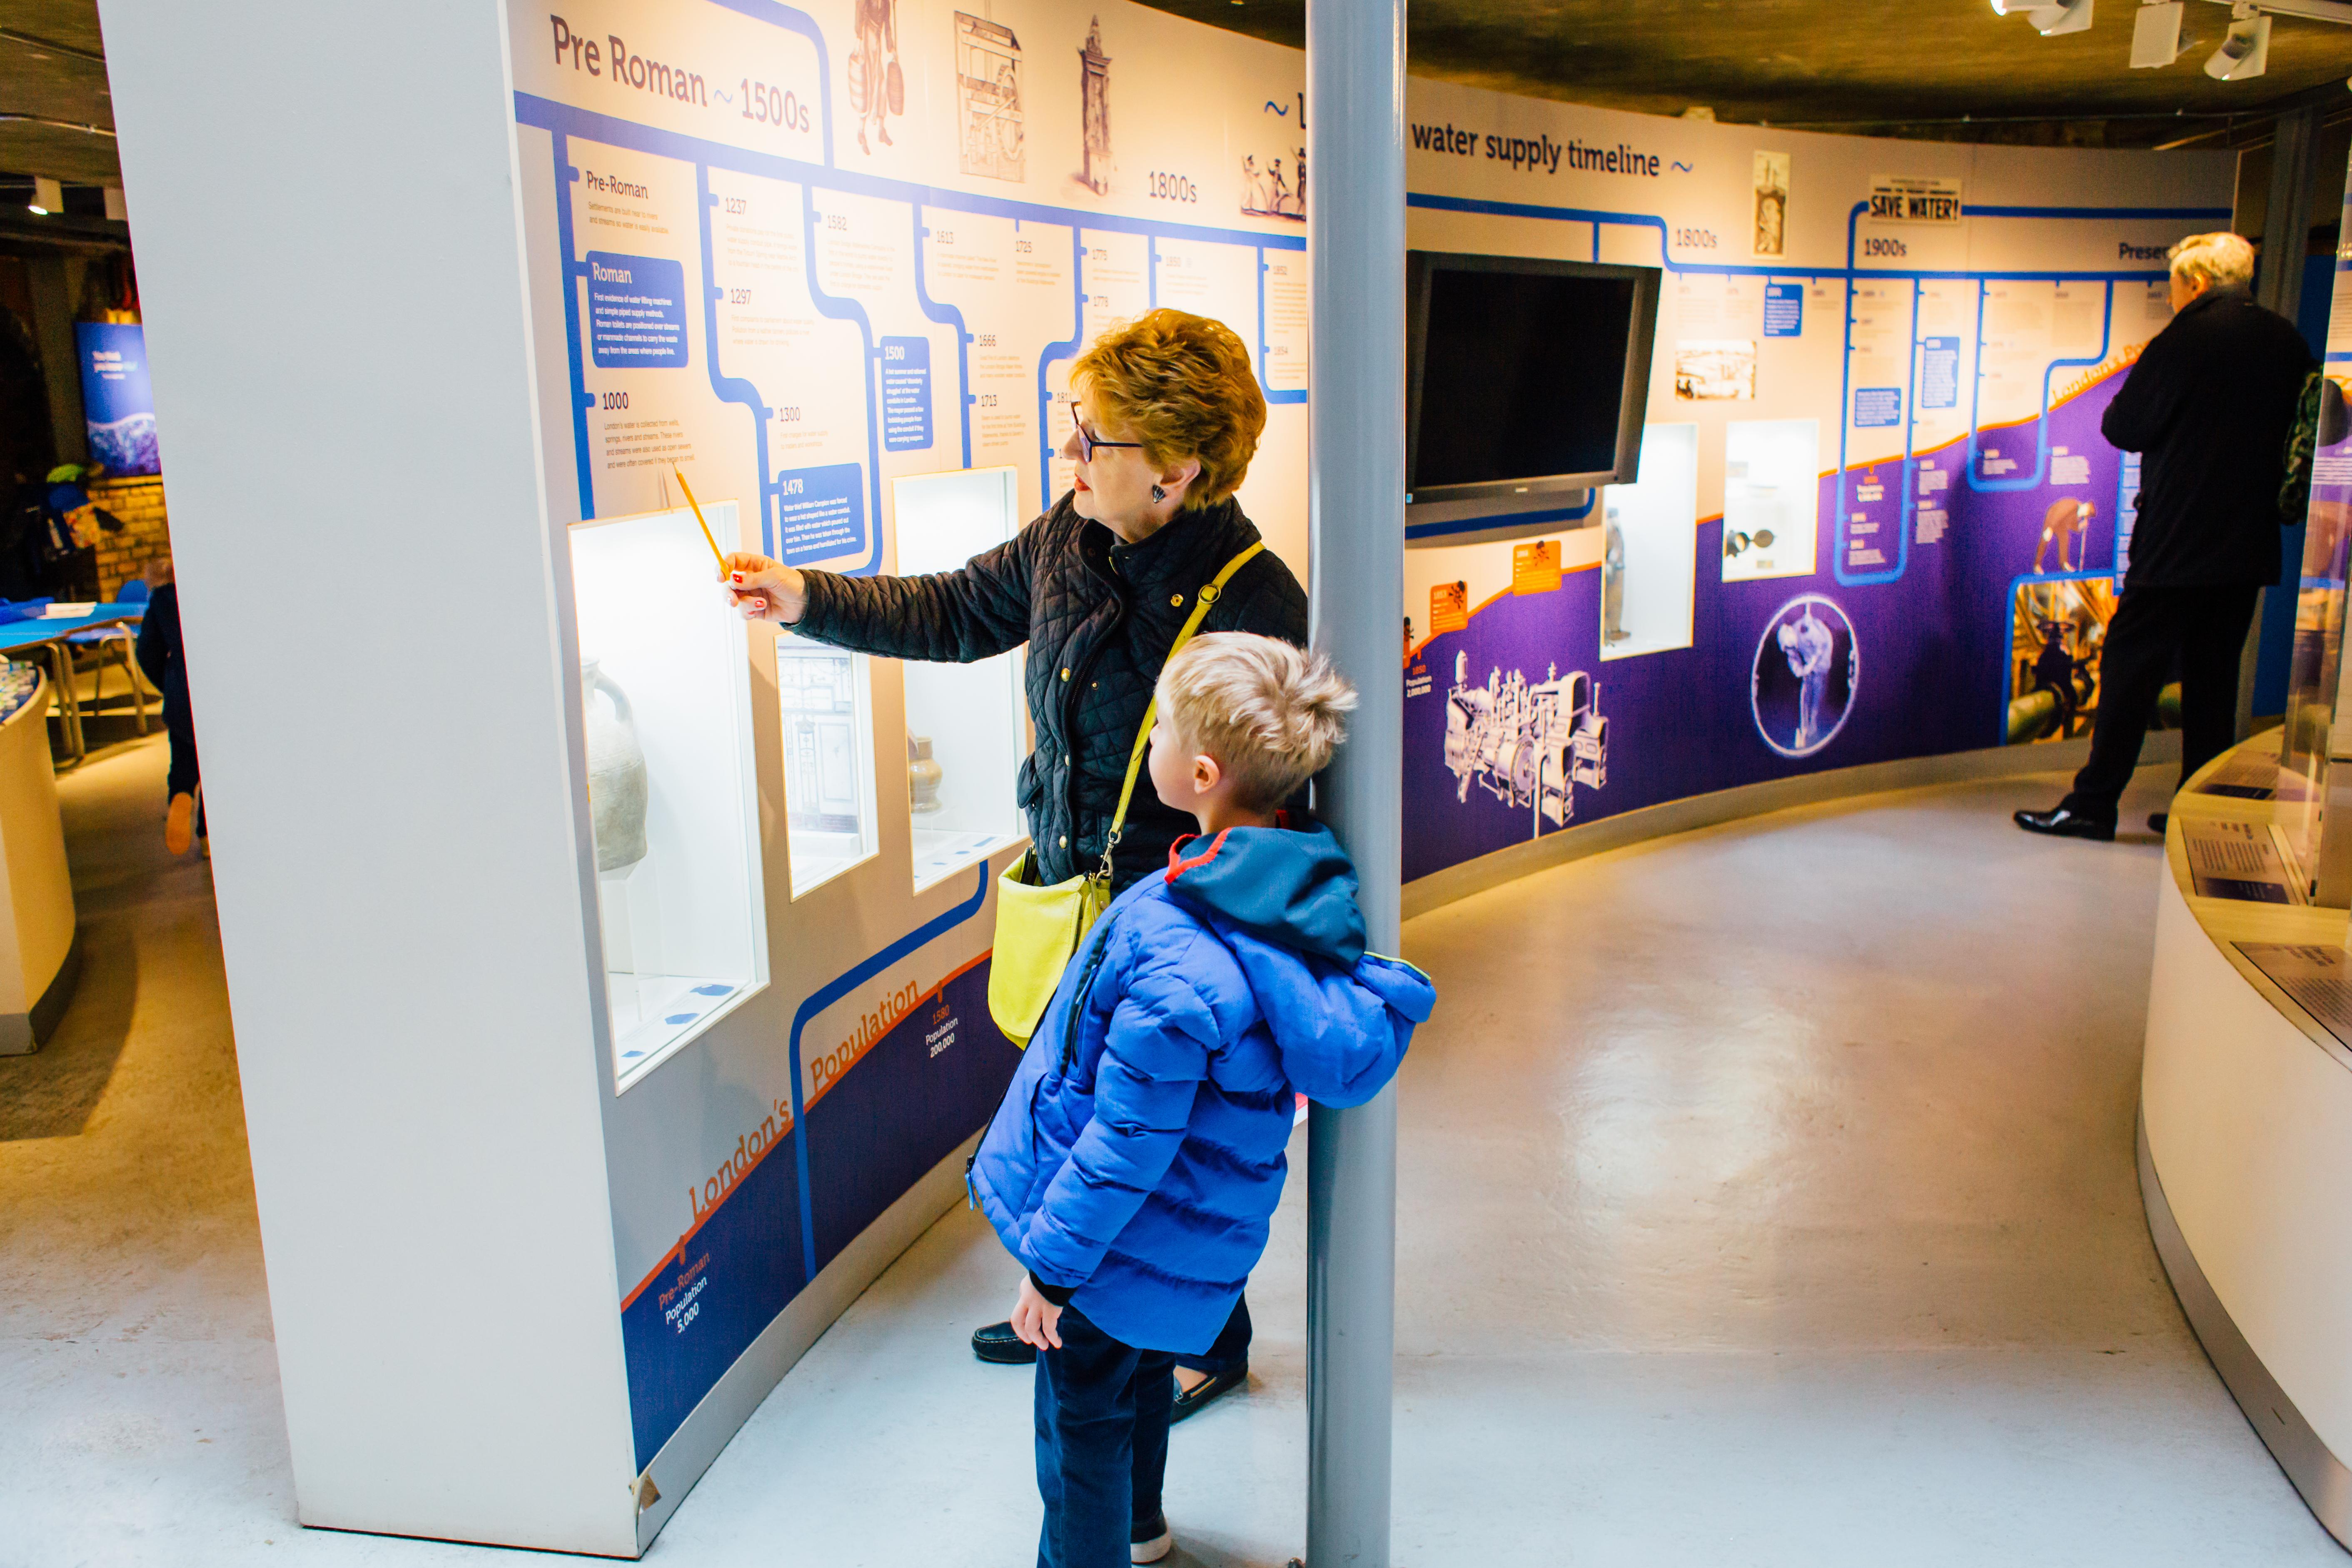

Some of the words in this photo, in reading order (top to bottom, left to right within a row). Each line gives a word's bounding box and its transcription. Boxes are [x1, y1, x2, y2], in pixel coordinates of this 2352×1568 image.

[550, 14, 601, 76] Pre
[608, 35, 707, 107] Roman
[741, 78, 810, 132] 1500s
[1412, 123, 1479, 156] water
[1486, 134, 1561, 174] supply
[1569, 139, 1660, 177] timeline
[586, 171, 648, 199] Pre-Roman
[1150, 171, 1196, 202] 1800s
[725, 197, 747, 215] 1237
[1872, 195, 1903, 217] SAVE
[1909, 198, 1958, 220] WATER!
[827, 214, 847, 231] 1582
[937, 230, 954, 244] 1613
[1675, 229, 1717, 248] 1800s
[1016, 241, 1033, 253] 1725
[1864, 238, 1907, 257] 1900s
[592, 262, 632, 284] Roman
[731, 288, 751, 305] 1297
[980, 334, 996, 346] 1666
[885, 346, 905, 361] 1500
[602, 392, 629, 410] 1000
[981, 394, 997, 407] 1713
[780, 406, 800, 422] 1300
[783, 478, 804, 496] 1478
[932, 1005, 950, 1025] 1580
[925, 1017, 958, 1046] Population
[930, 1034, 955, 1058] 200,000
[688, 1099, 790, 1224] London's
[811, 979, 920, 1093] Population
[658, 1252, 711, 1310] Pre-Roman
[666, 1276, 707, 1324] Population
[676, 1302, 699, 1333] 5,000
